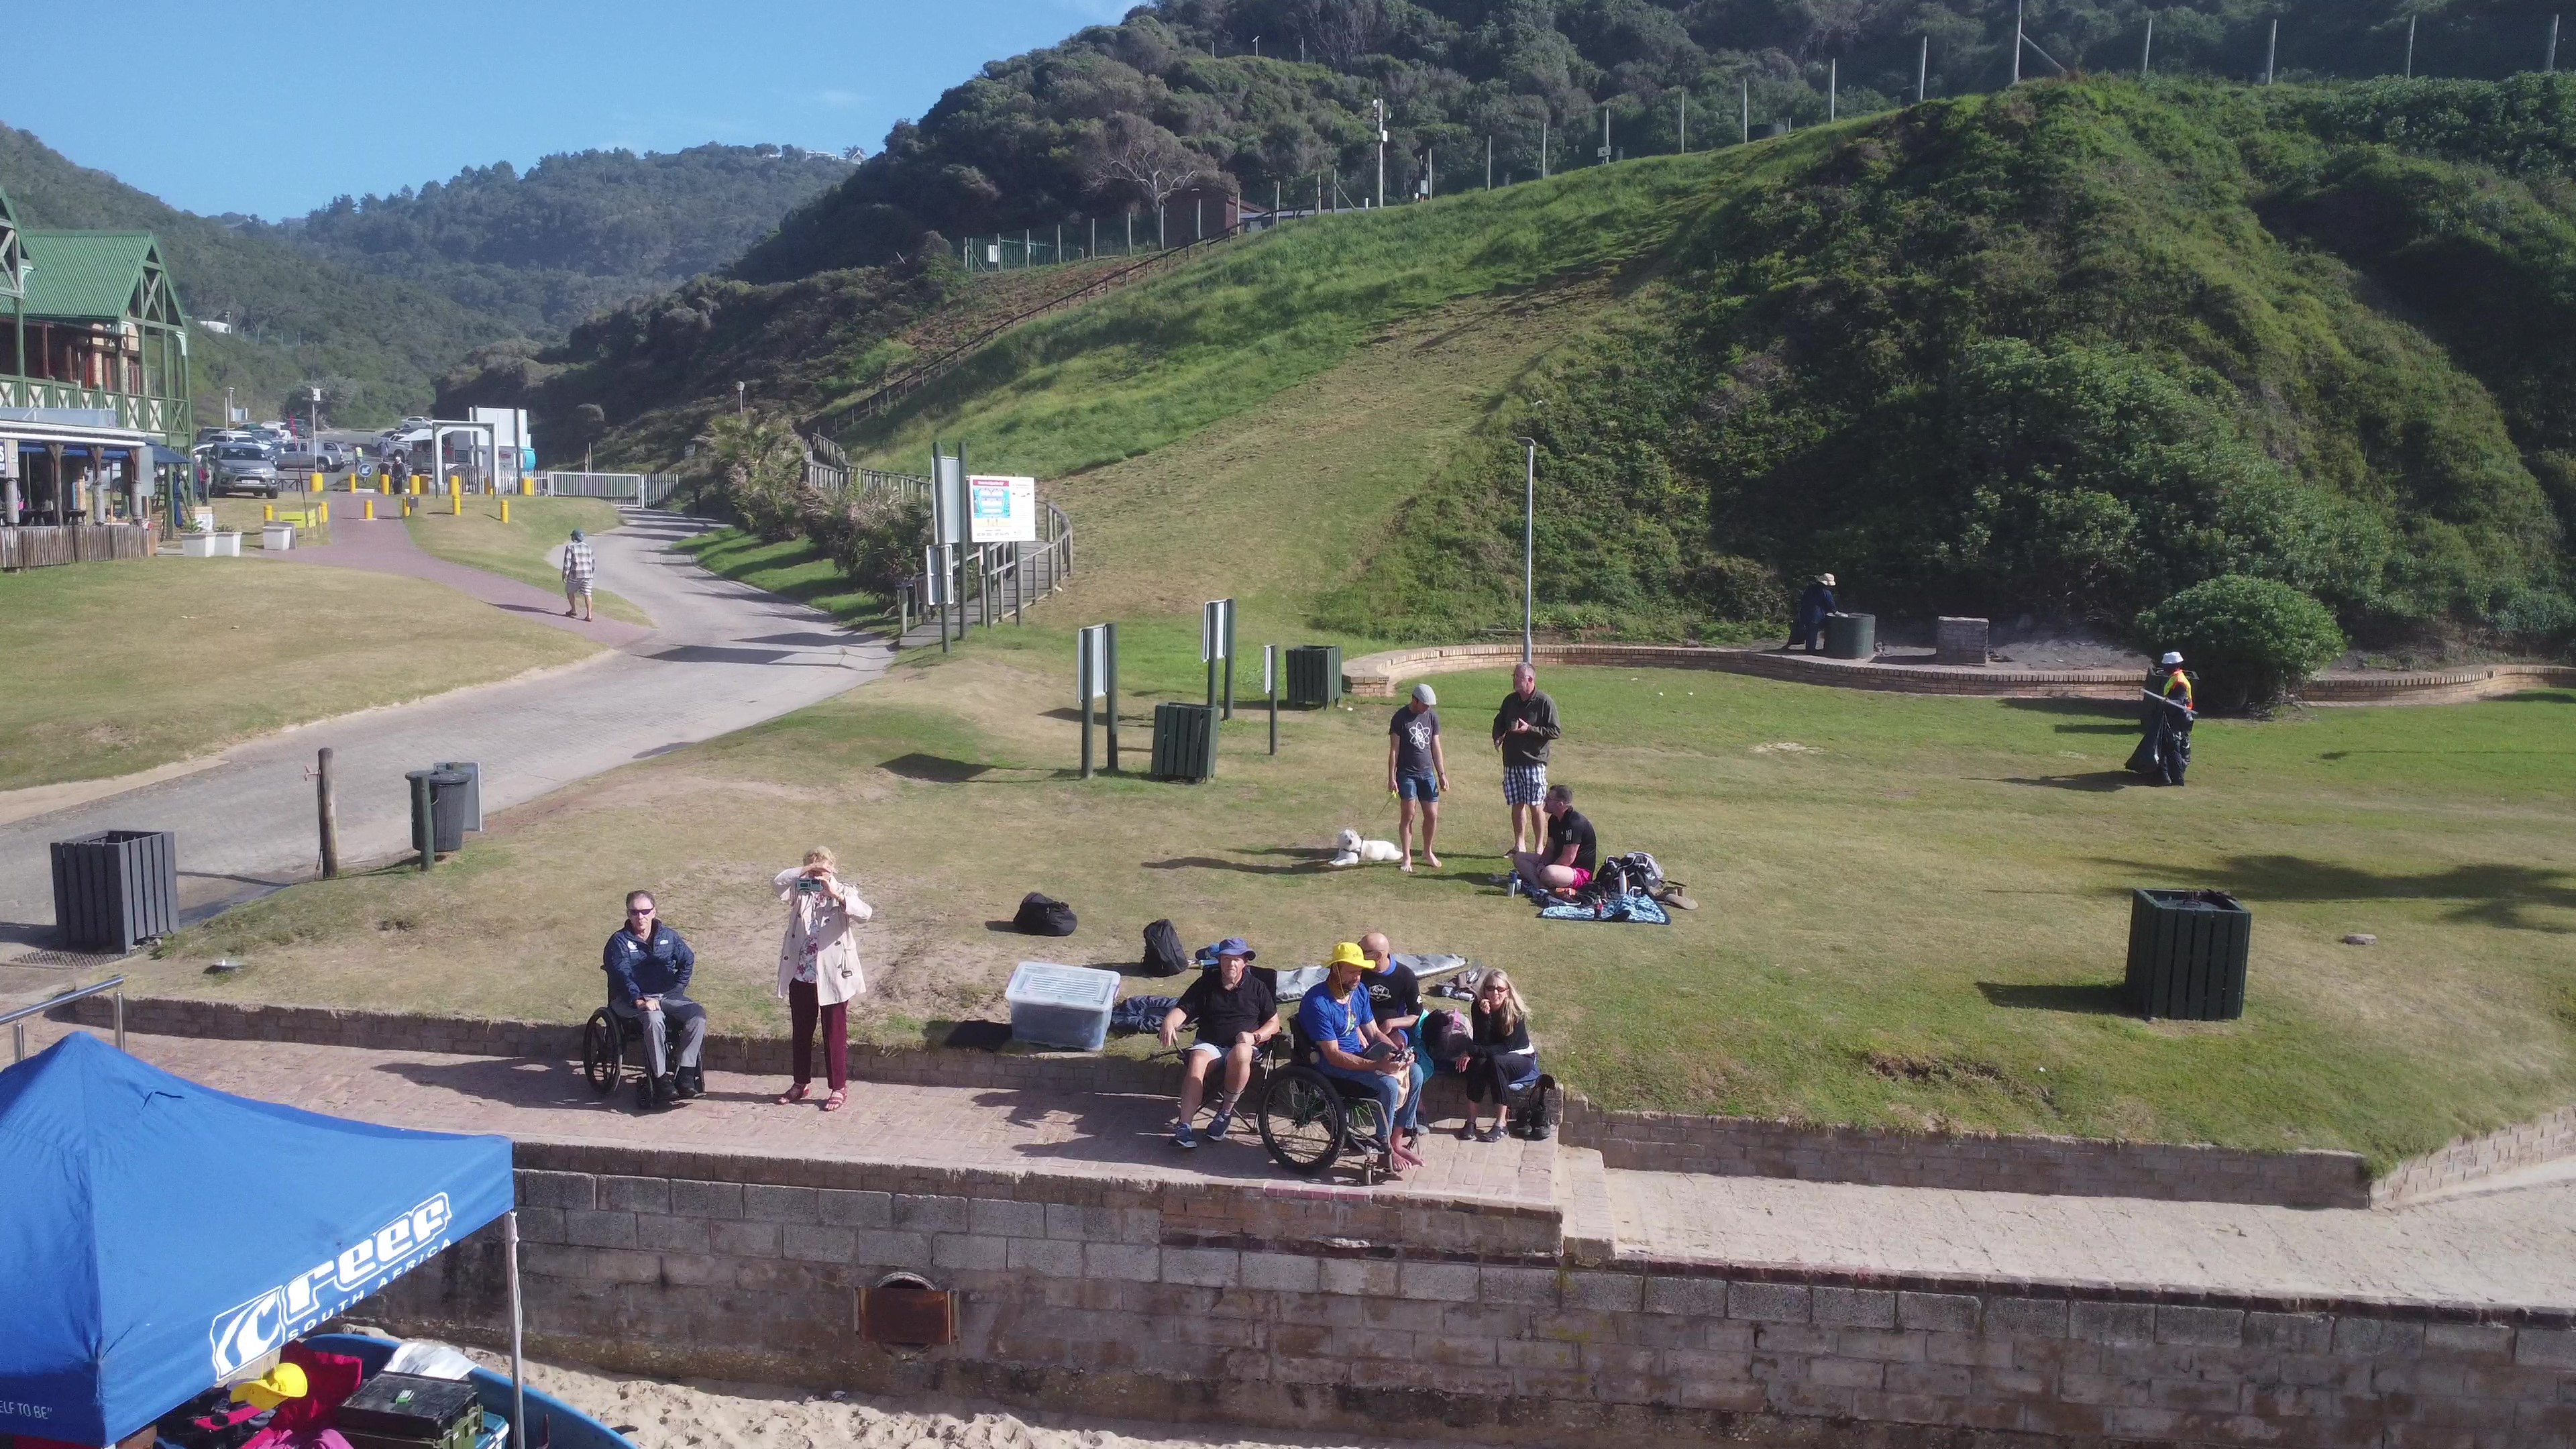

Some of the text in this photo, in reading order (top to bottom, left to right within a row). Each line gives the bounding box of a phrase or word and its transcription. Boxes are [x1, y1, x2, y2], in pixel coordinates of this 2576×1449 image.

[288, 1198, 445, 1315] reef
[288, 1238, 452, 1340] SOUTH AFRICA
[17, 1403, 31, 1417] TO
